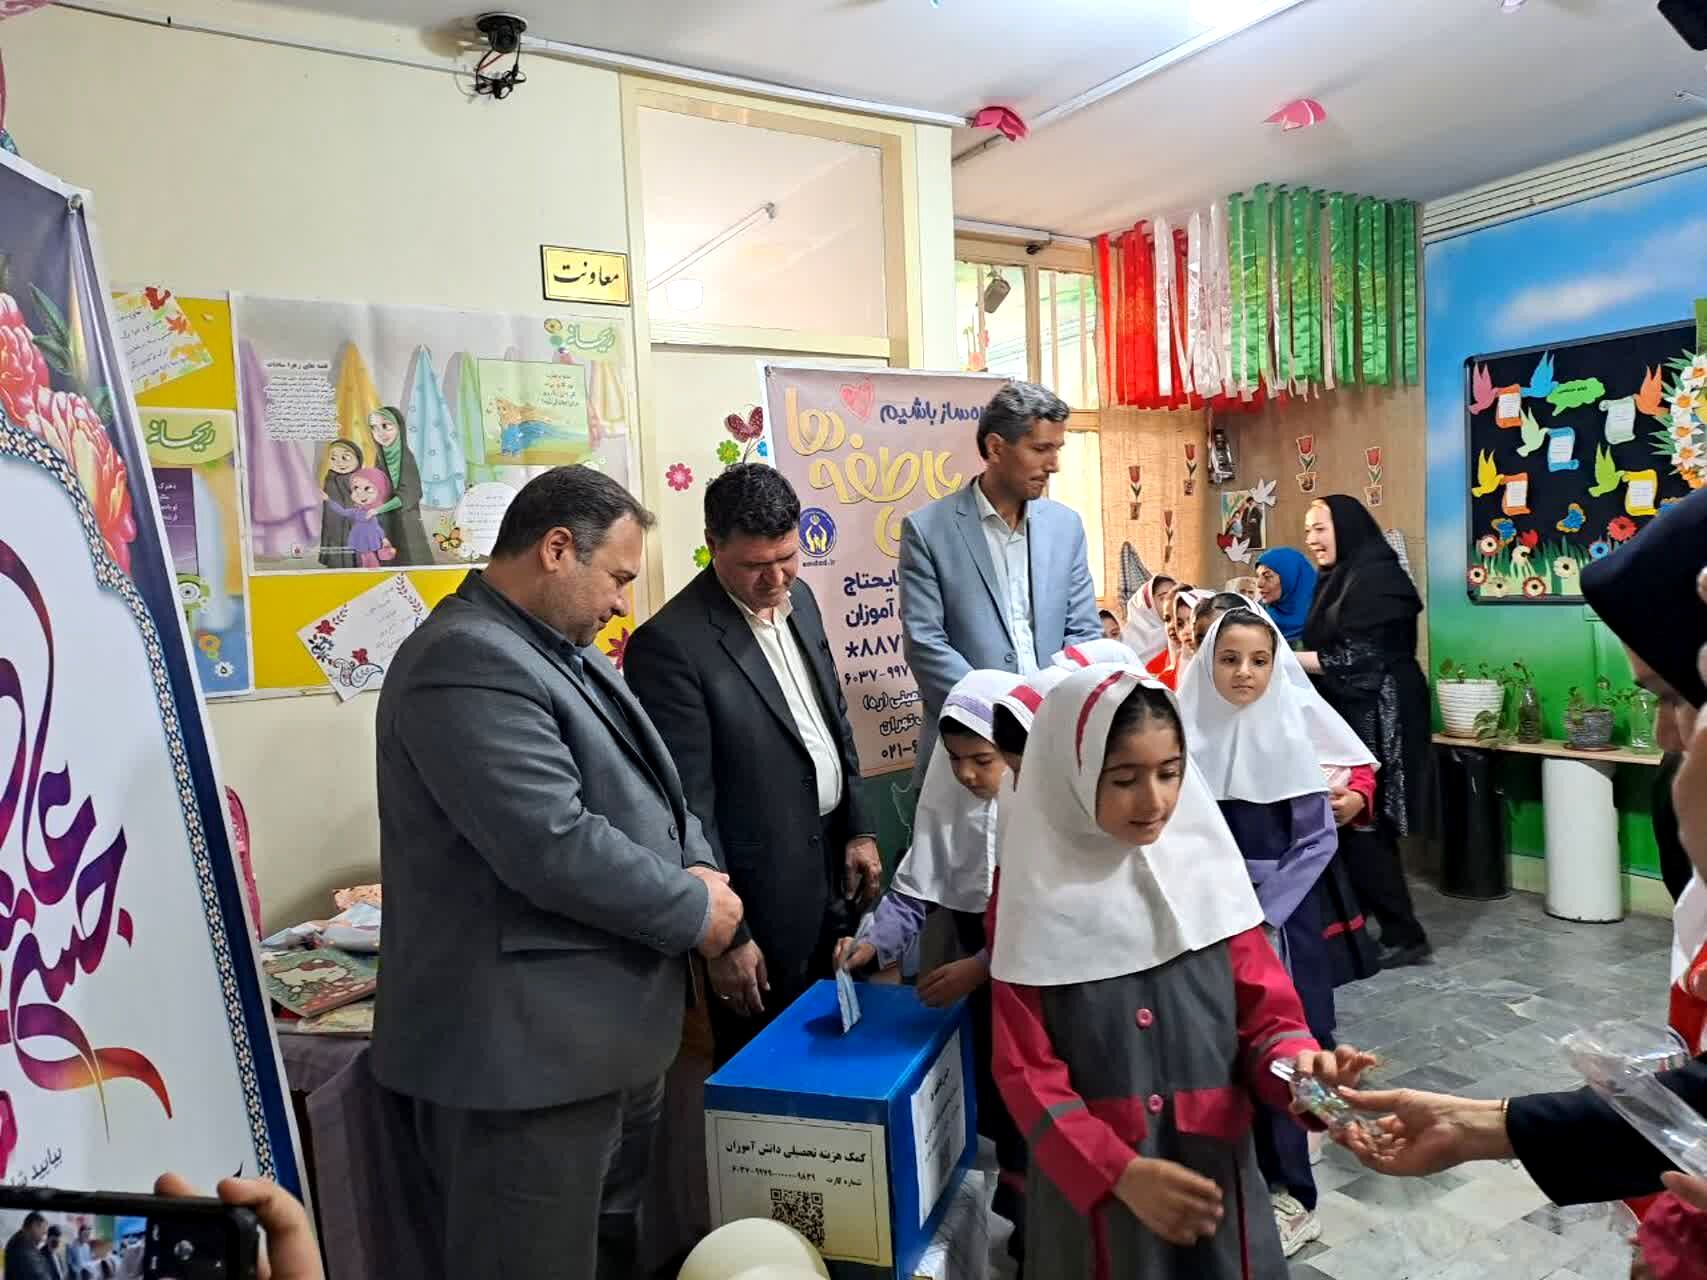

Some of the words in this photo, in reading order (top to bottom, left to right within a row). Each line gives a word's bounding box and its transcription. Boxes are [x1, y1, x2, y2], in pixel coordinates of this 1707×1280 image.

[553, 261, 619, 286] معاونت
[880, 397, 938, 425] باشیم
[809, 433, 962, 504] عاطفه
[844, 569, 899, 597] ایحتاج
[846, 598, 895, 628] آموزان
[844, 664, 909, 686] ۶۰۳۷-۹۹۷
[890, 689, 920, 710] مینی
[880, 713, 914, 736] تهران
[725, 1140, 756, 1154] آموزان
[757, 1142, 782, 1156] دانش
[783, 1144, 817, 1158] تحصیلی
[819, 1149, 842, 1163] هزینه
[845, 1151, 867, 1162] کمک
